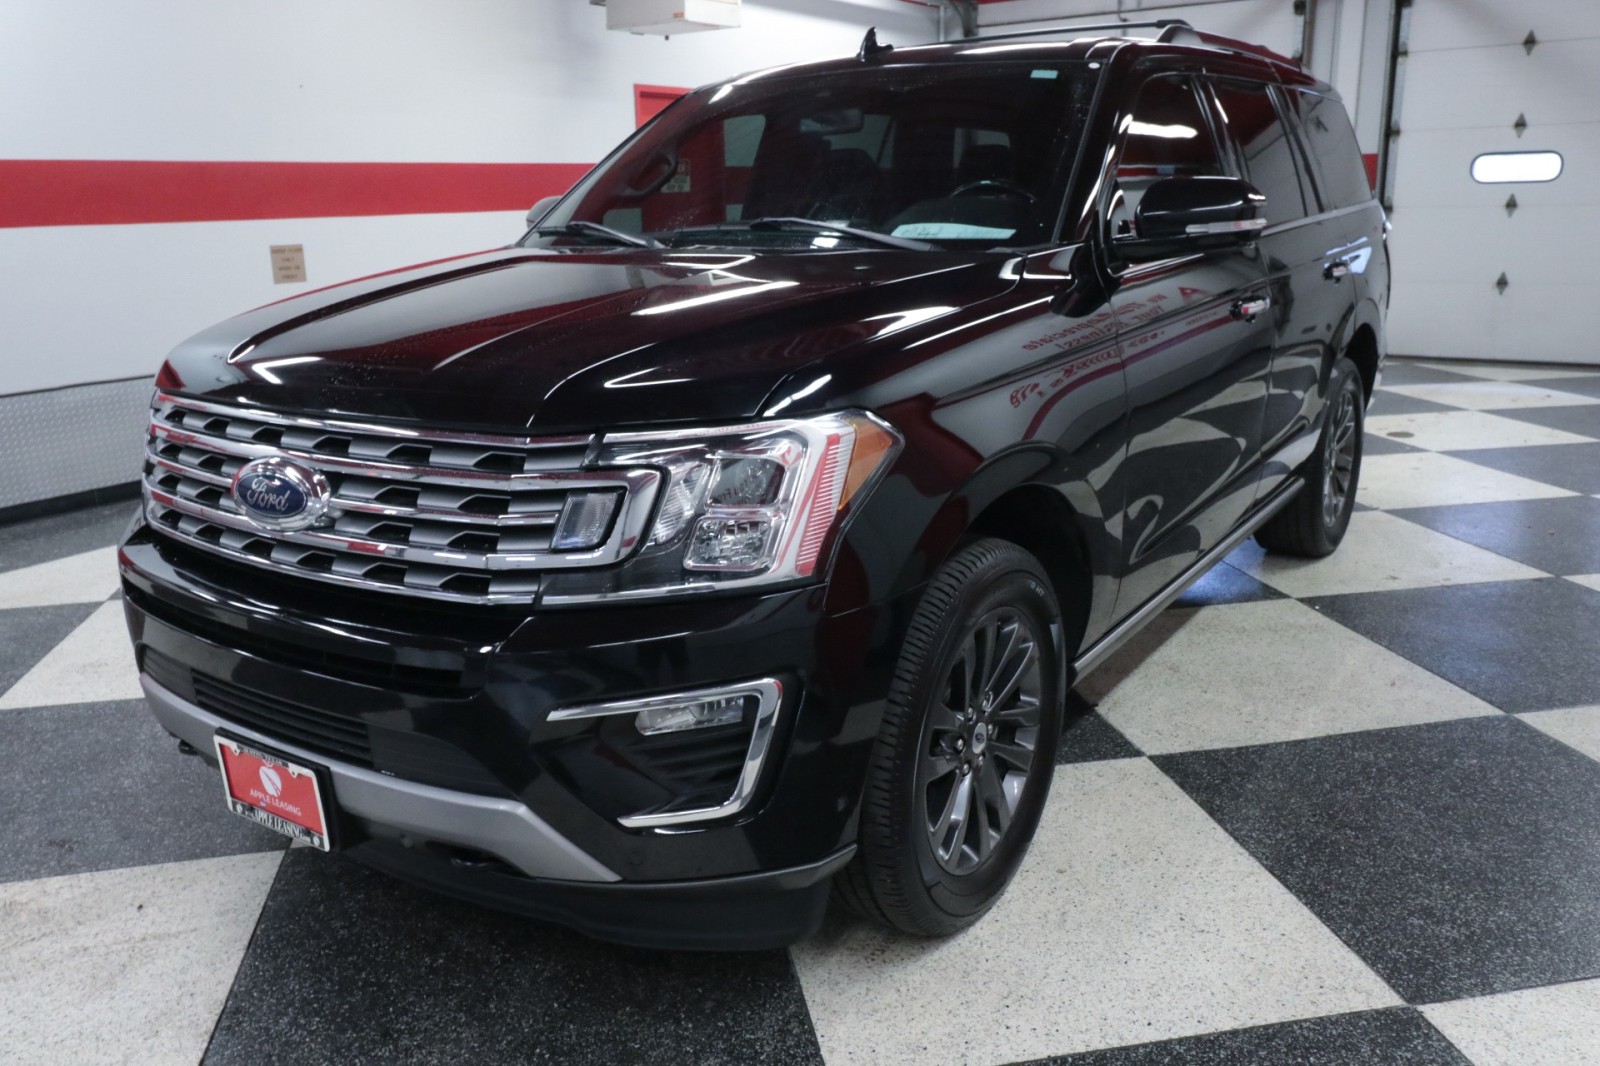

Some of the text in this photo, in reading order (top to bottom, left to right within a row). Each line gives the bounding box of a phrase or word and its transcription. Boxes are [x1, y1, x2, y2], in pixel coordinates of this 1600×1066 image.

[246, 477, 290, 511] Ford
[250, 789, 271, 803] APPLE
[271, 798, 302, 816] LEASING
